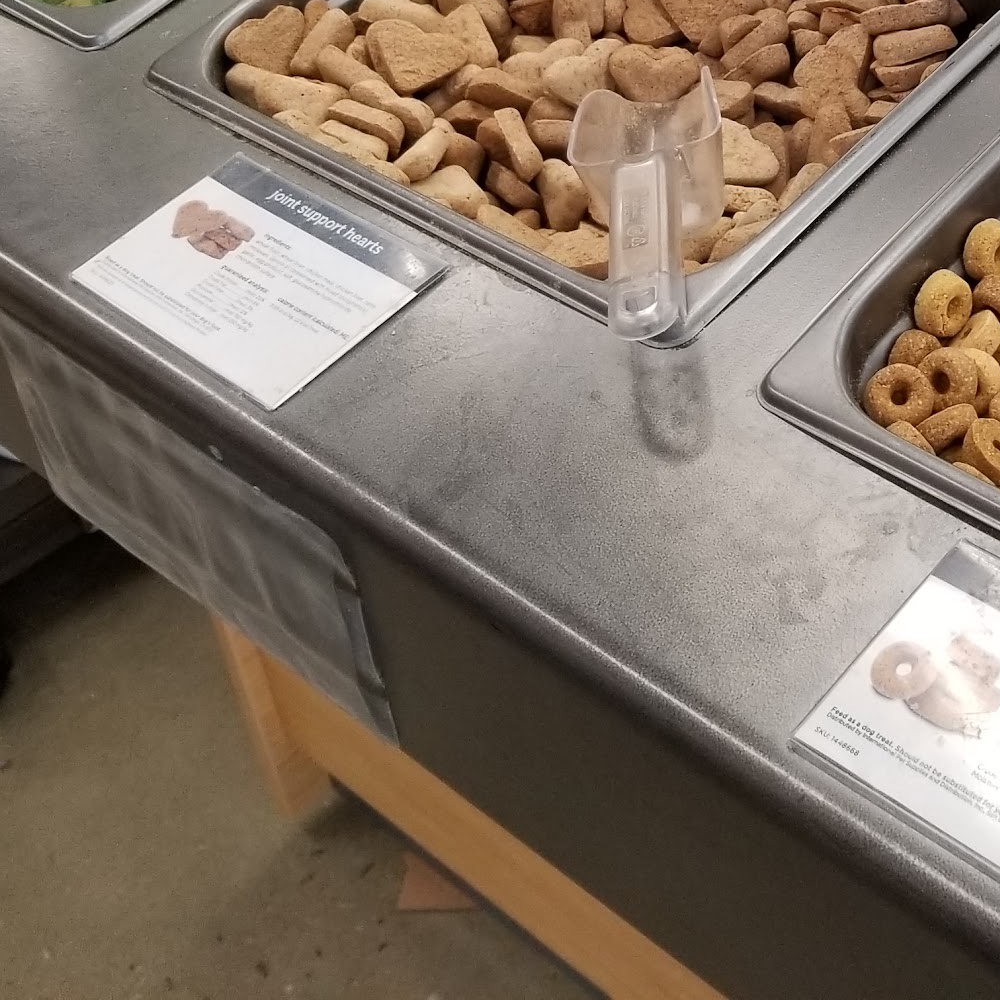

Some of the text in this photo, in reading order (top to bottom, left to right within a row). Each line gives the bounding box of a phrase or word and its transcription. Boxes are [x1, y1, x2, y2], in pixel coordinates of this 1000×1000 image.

[265, 188, 384, 254] joint support hearts
[826, 712, 856, 732] Distributed
[862, 732, 895, 756] International
[831, 706, 848, 719] Feed
[860, 725, 875, 737] dog
[875, 732, 894, 748] treat.
[894, 745, 919, 763] Should
[919, 761, 932, 771] not
[941, 775, 983, 802] substituted
